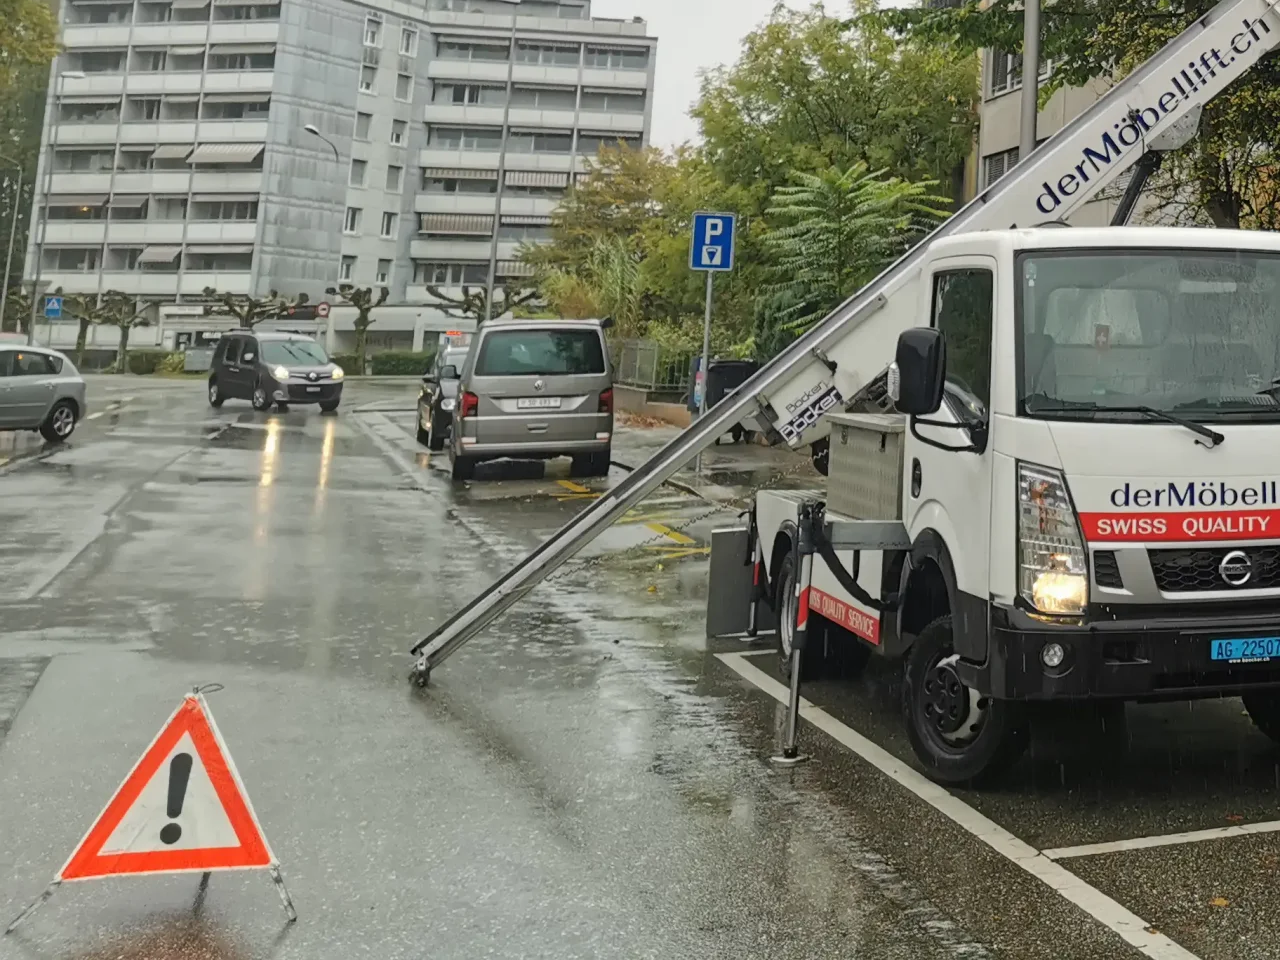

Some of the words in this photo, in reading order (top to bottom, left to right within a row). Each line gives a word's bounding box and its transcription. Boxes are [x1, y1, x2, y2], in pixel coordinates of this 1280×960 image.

[1034, 16, 1271, 215] derMöbellift.ch
[705, 218, 723, 245] P
[780, 389, 837, 442] Böcker
[1097, 518, 1167, 536] SWISS
[1182, 516, 1271, 536] QUALITY
[822, 595, 846, 622] QUALITY
[848, 608, 874, 638] SERVICE
